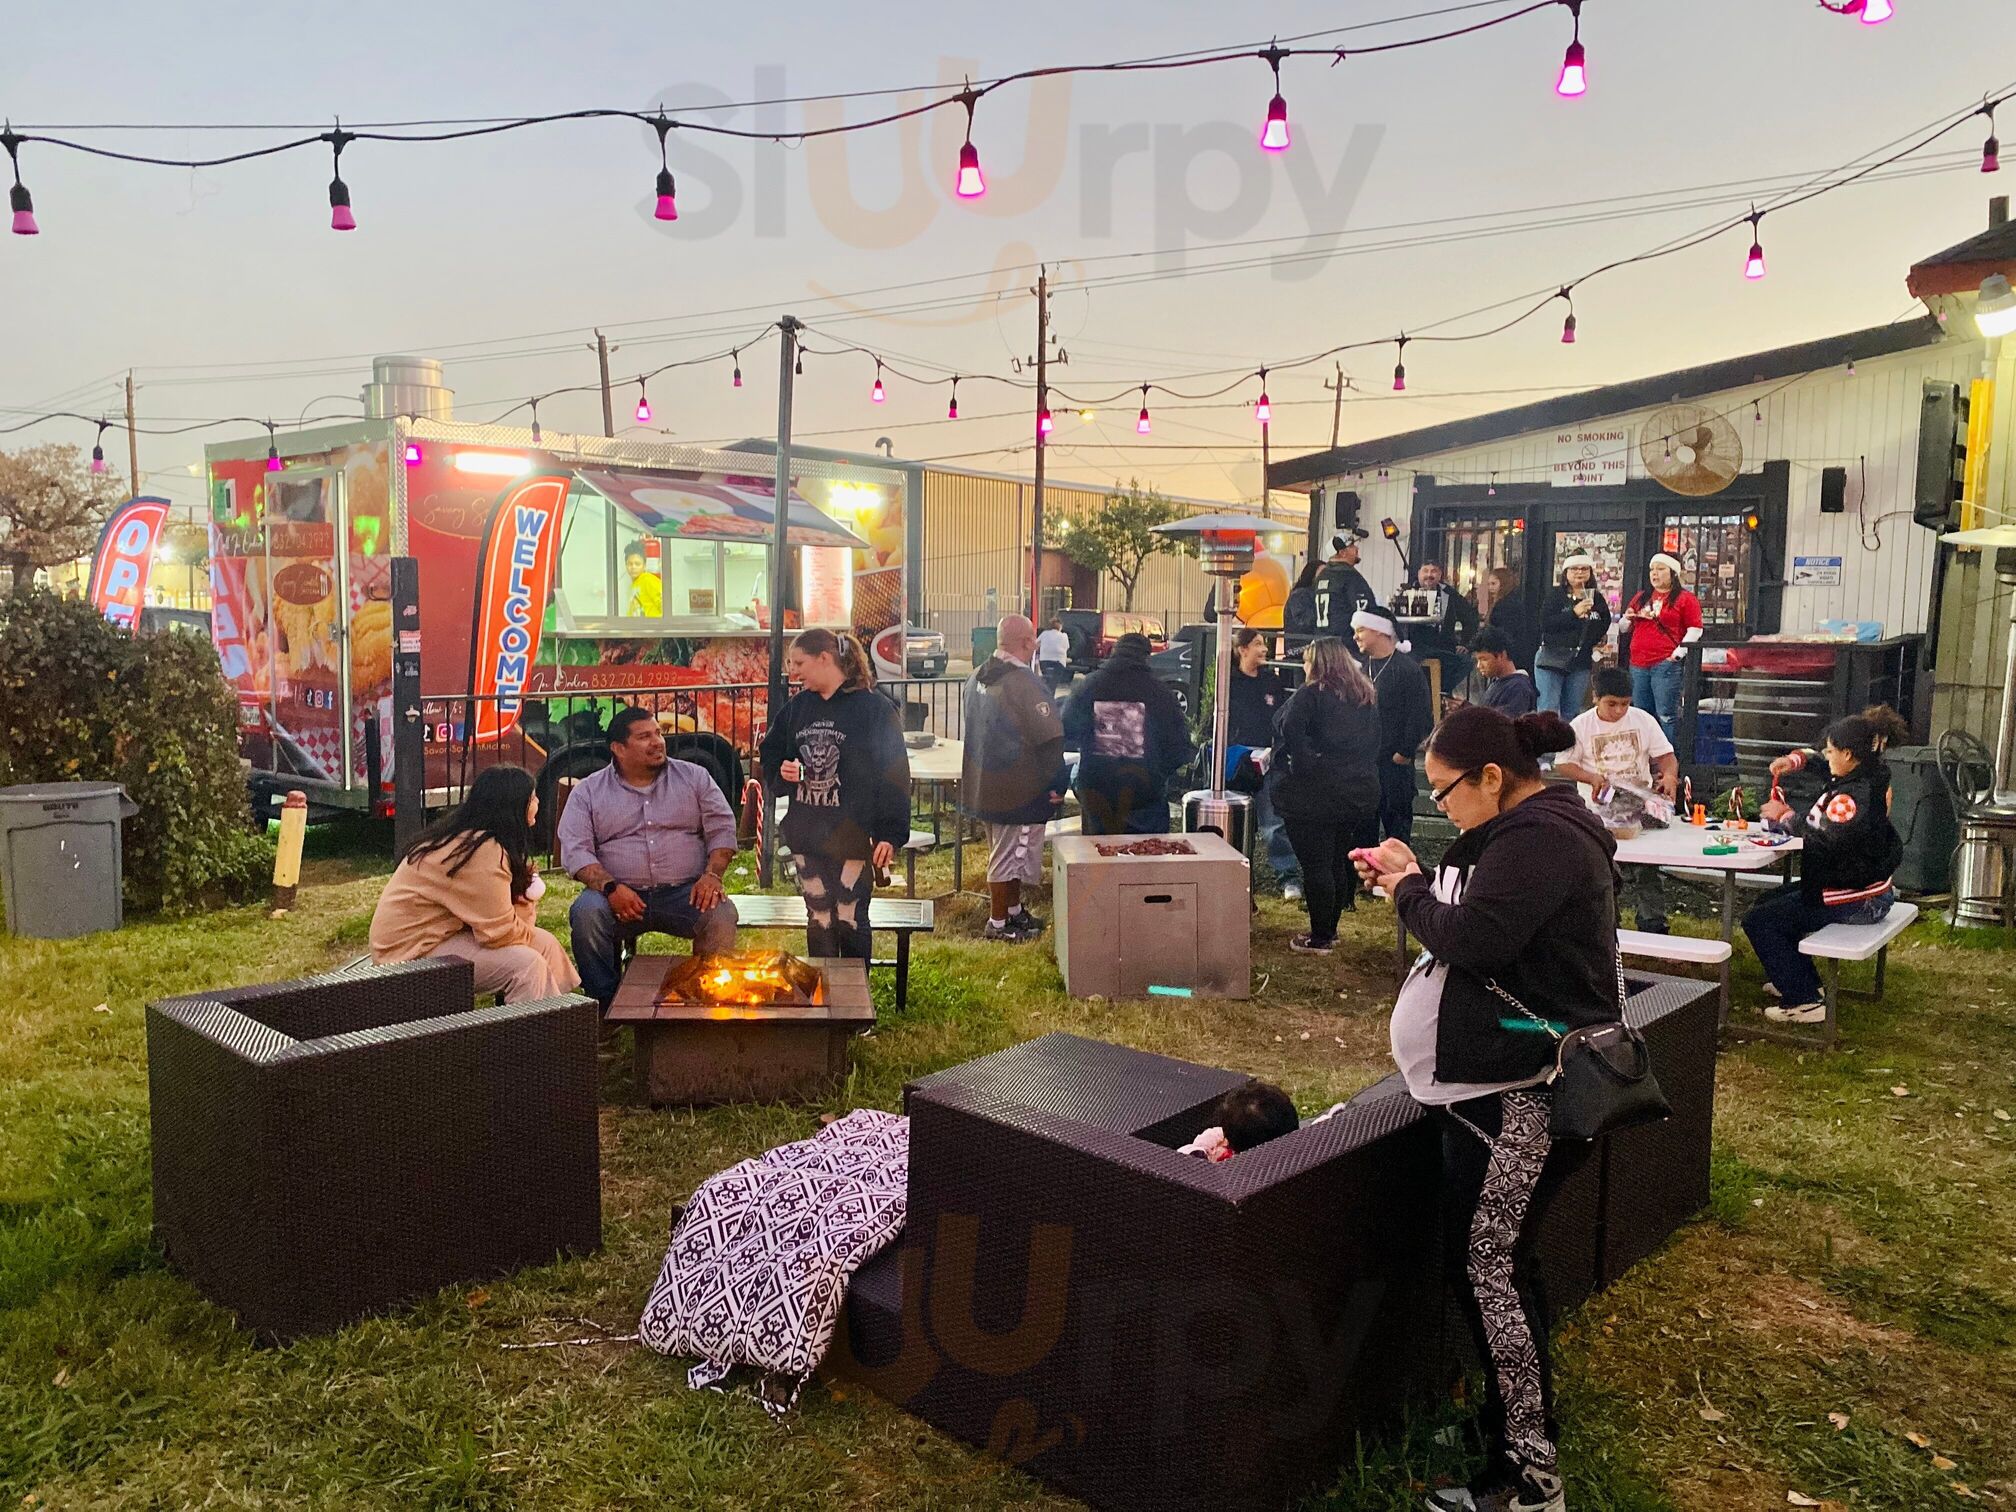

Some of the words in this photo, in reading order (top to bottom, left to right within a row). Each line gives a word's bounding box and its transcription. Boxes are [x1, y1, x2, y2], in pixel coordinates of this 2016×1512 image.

[1557, 434, 1572, 443] NO
[1577, 432, 1624, 442] SMOKING
[1553, 461, 1596, 472] BEYOND
[1602, 460, 1625, 470] THIS
[1572, 473, 1604, 482] POINT
[1806, 558, 1830, 566] NOTICE
[105, 519, 150, 629] OPE
[496, 506, 548, 711] WELCOME
[1315, 593, 1329, 628] 17
[1356, 600, 1368, 611] 17
